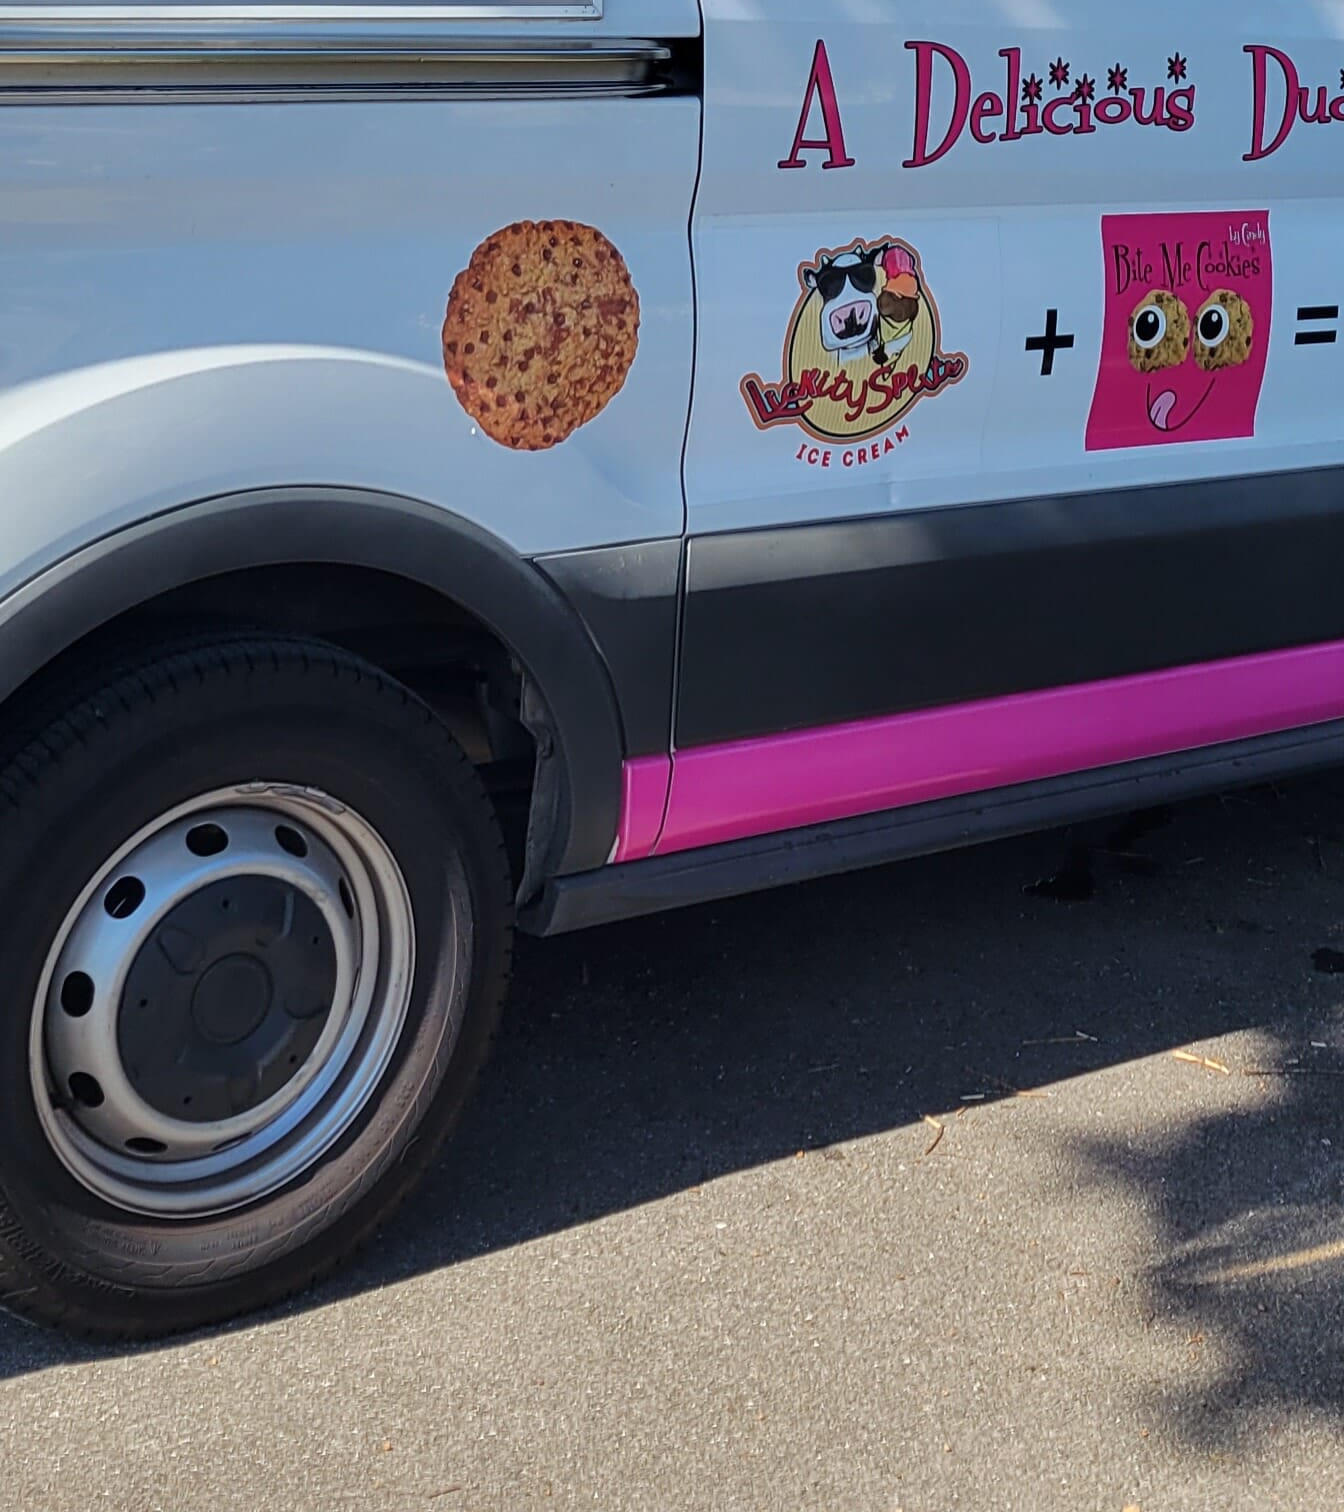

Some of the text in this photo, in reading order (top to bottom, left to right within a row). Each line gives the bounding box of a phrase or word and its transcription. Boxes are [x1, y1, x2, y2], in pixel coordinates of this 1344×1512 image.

[777, 39, 855, 169] A
[902, 40, 1196, 169] Delicious
[1111, 241, 1261, 295] Bite Me Cookies
[795, 424, 910, 468] ICE CREAM
